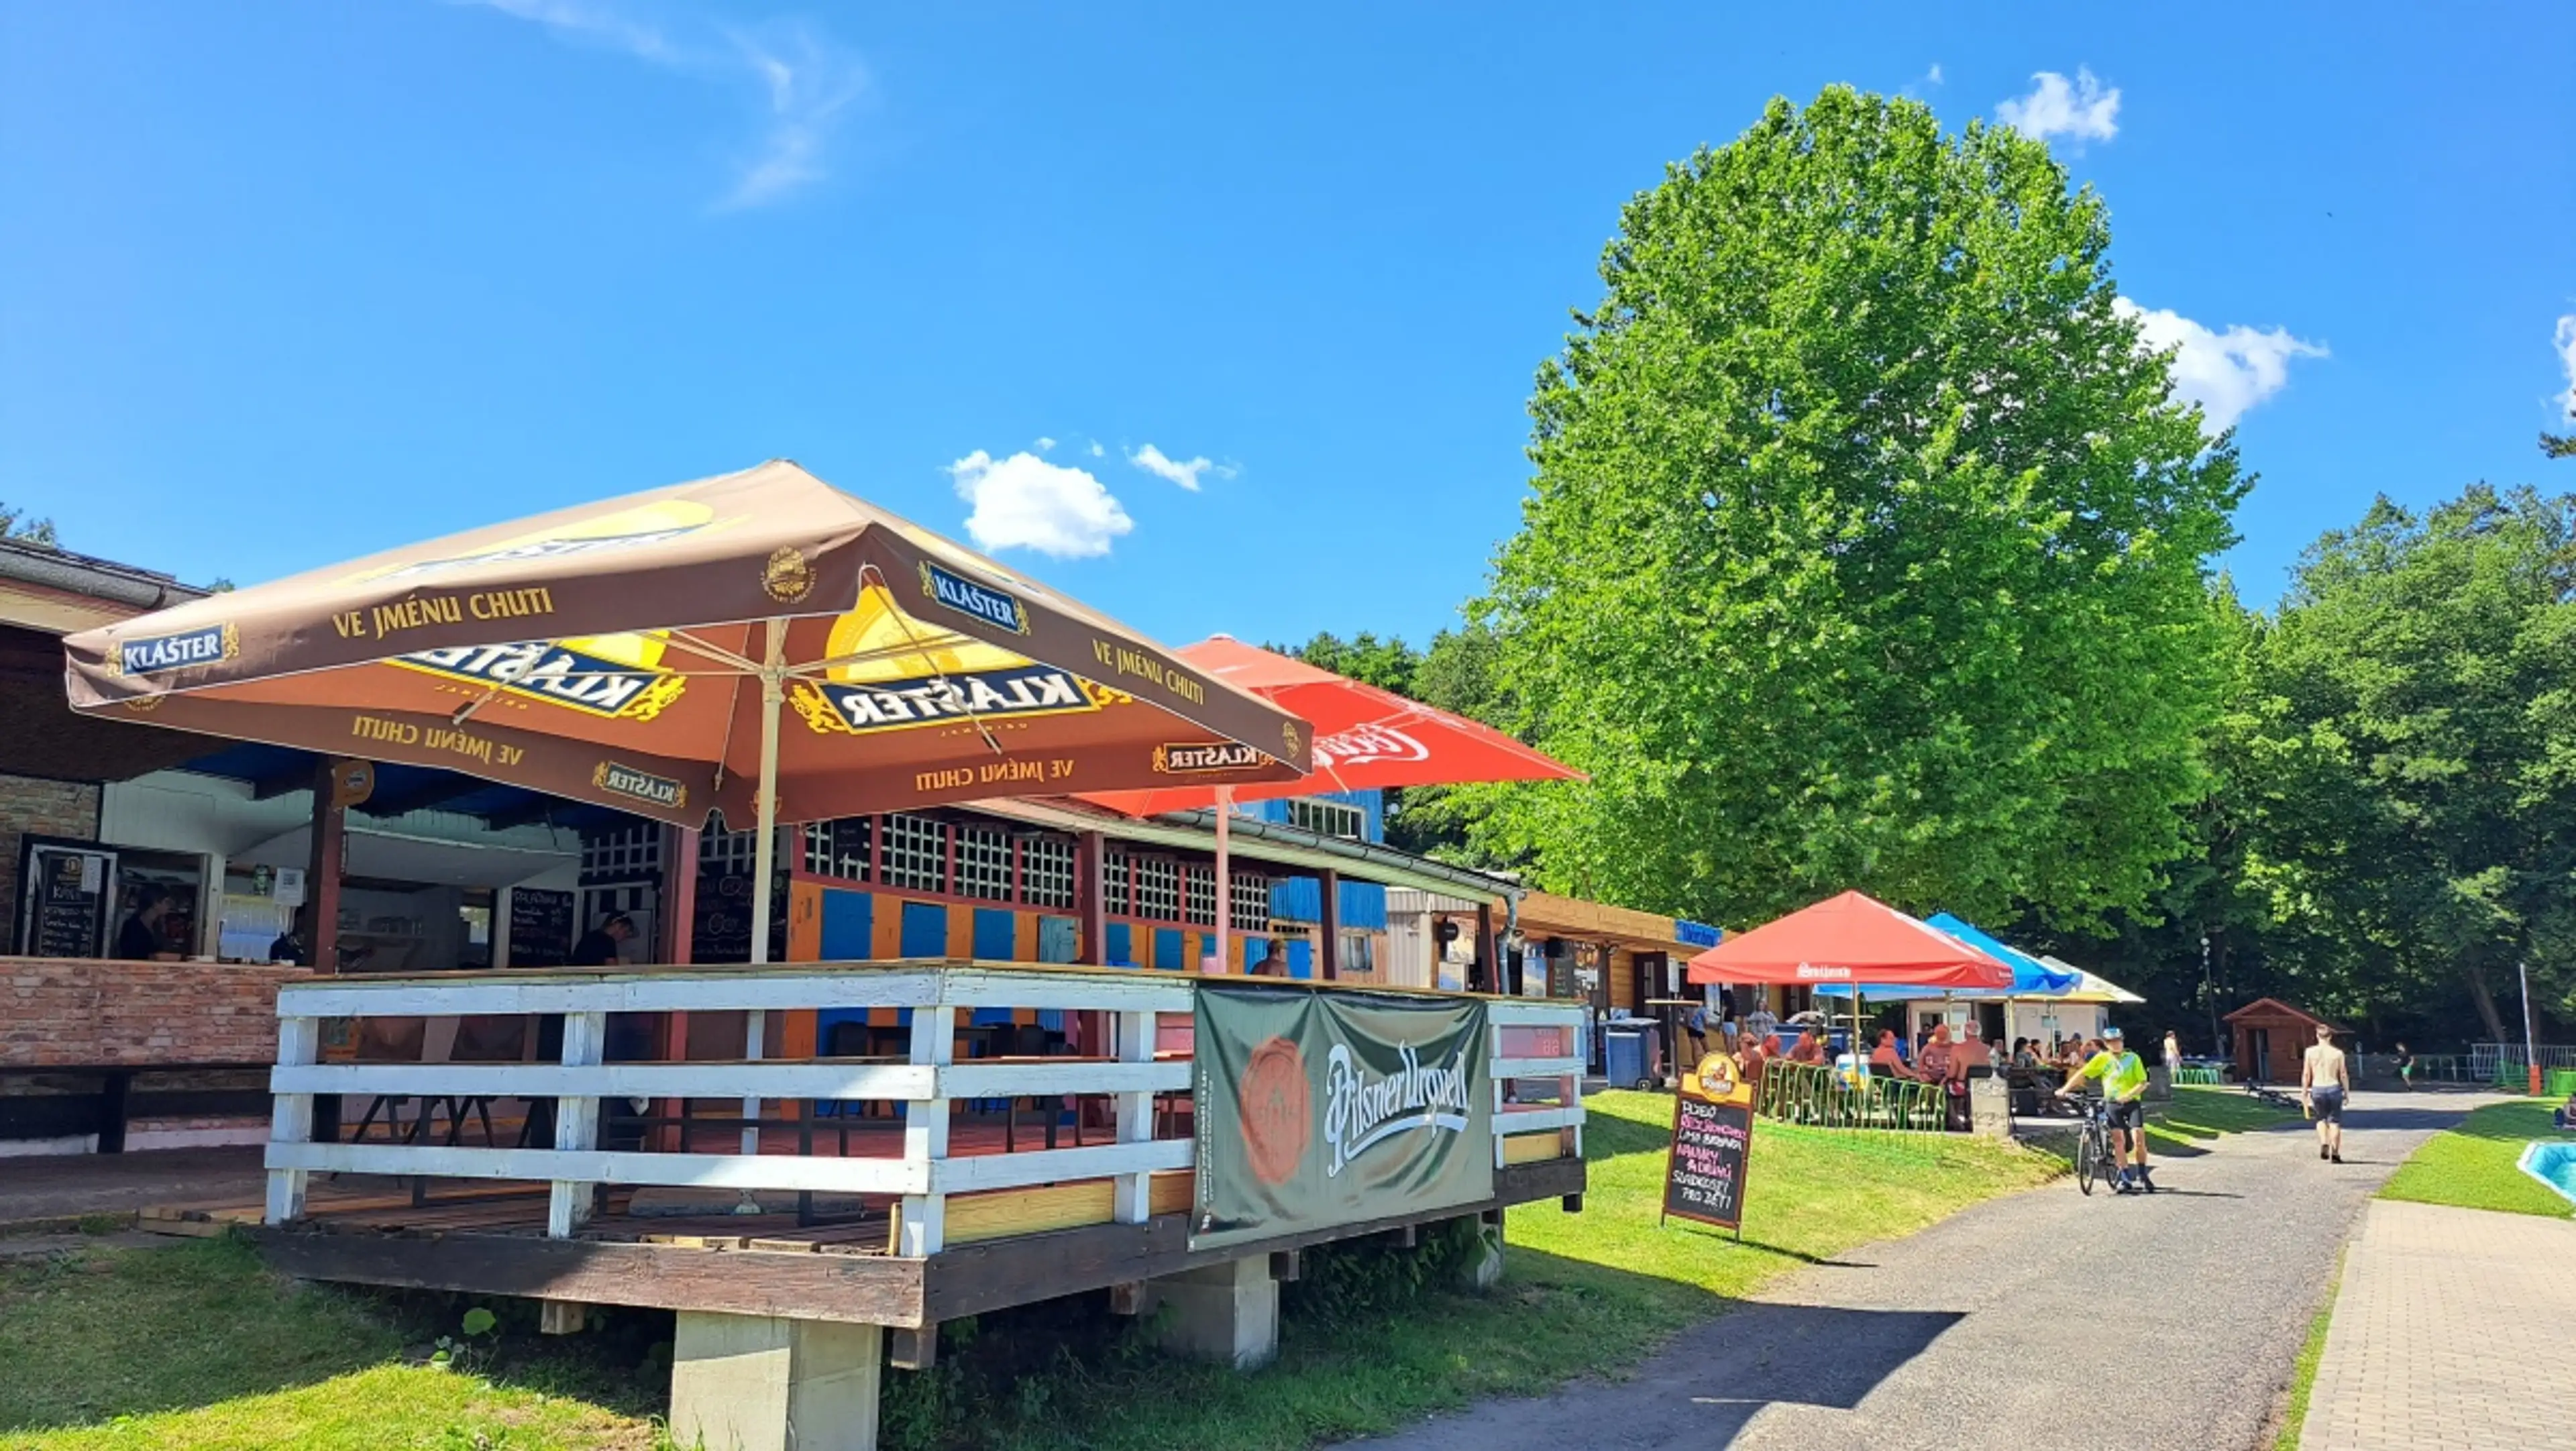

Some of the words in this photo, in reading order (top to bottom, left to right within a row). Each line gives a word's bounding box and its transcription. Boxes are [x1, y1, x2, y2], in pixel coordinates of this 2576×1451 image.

[332, 611, 366, 638] VE
[371, 593, 463, 640] JMÉNU
[470, 587, 555, 620] CHUTI
[934, 575, 1016, 627] KLÁŠTER
[123, 633, 220, 671] KLÁŠTER
[1091, 639, 1114, 667] VE
[1116, 649, 1164, 685] JMÉNU
[1165, 669, 1204, 706] CHUTI
[1324, 1042, 1406, 1178] Pilsner
[1399, 1038, 1468, 1140] Urquell
